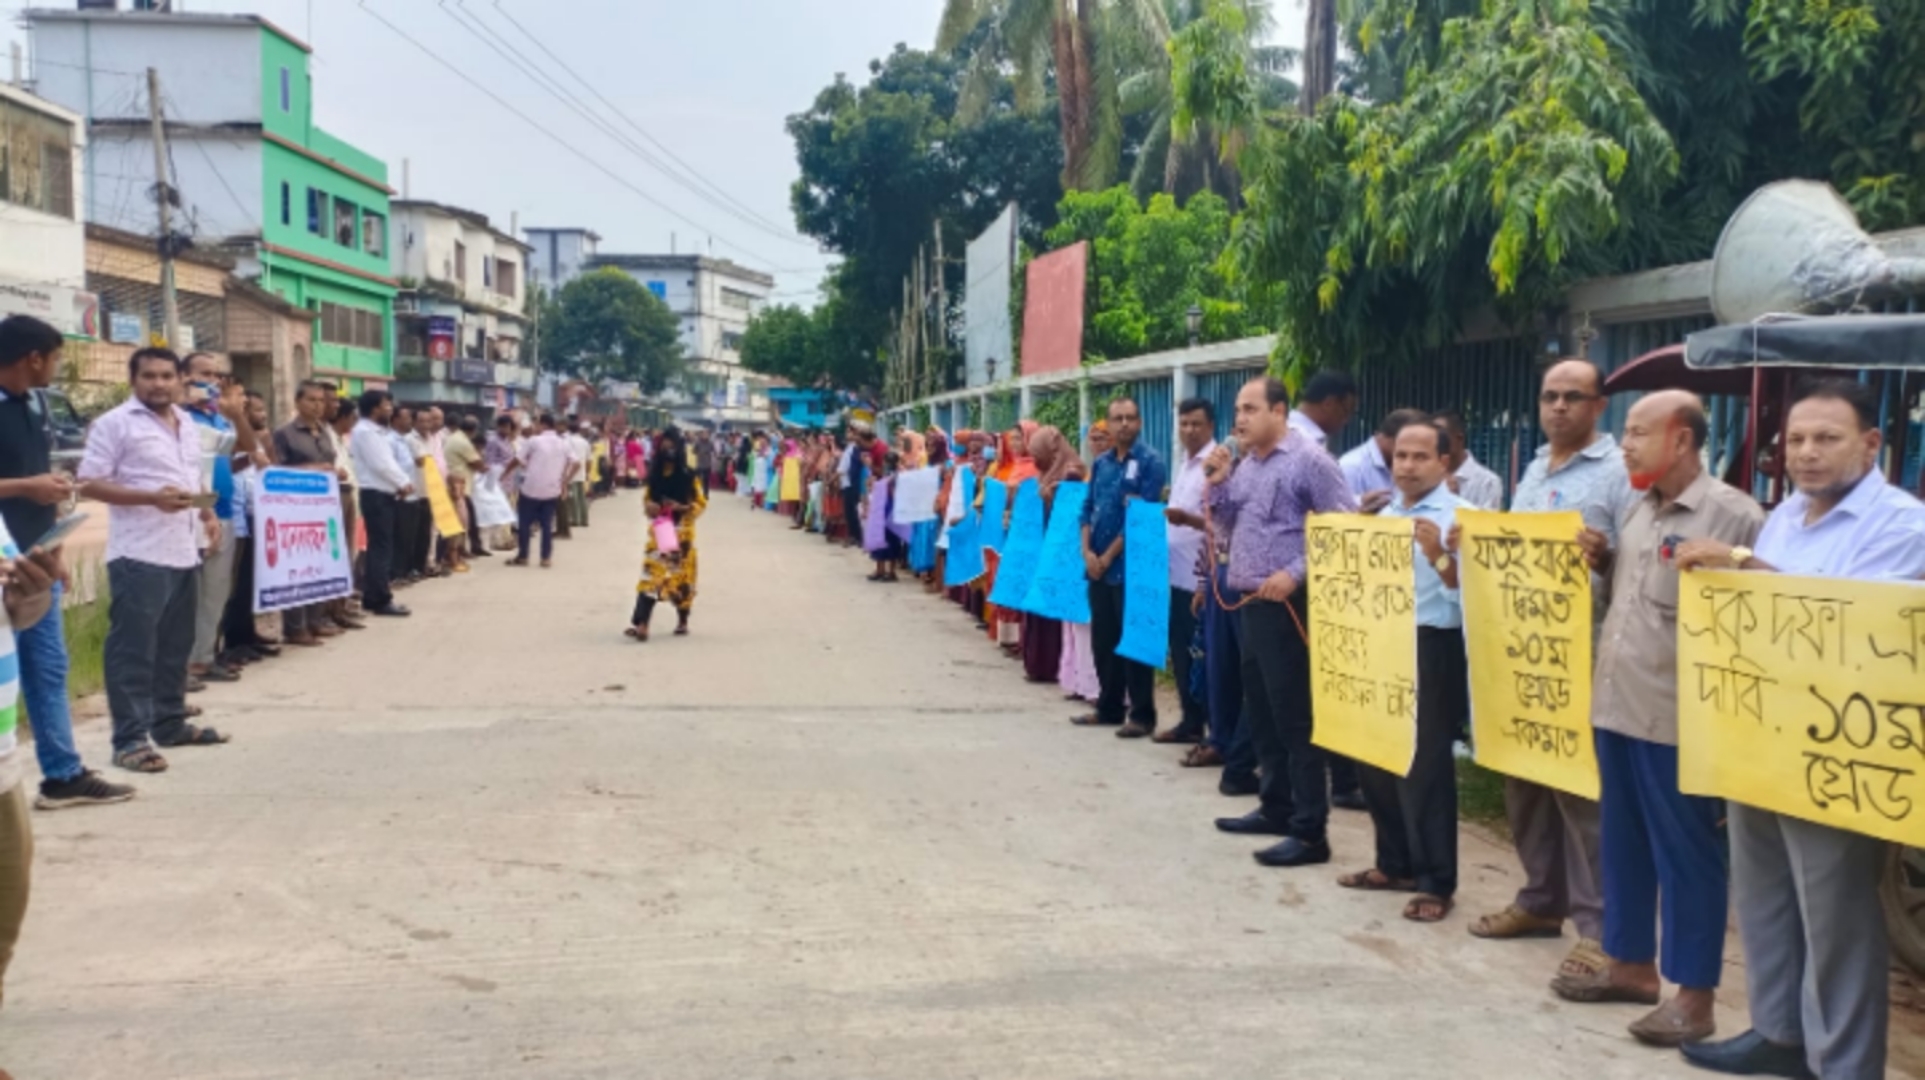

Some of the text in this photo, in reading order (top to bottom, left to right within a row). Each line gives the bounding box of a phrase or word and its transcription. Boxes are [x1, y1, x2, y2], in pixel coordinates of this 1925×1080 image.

[1471, 526, 1533, 578] যতই
[1498, 572, 1576, 627] দ্বিমত
[1682, 586, 1757, 655] এক
[1499, 716, 1580, 759] একমত
[1802, 750, 1916, 822] গ্রেড
